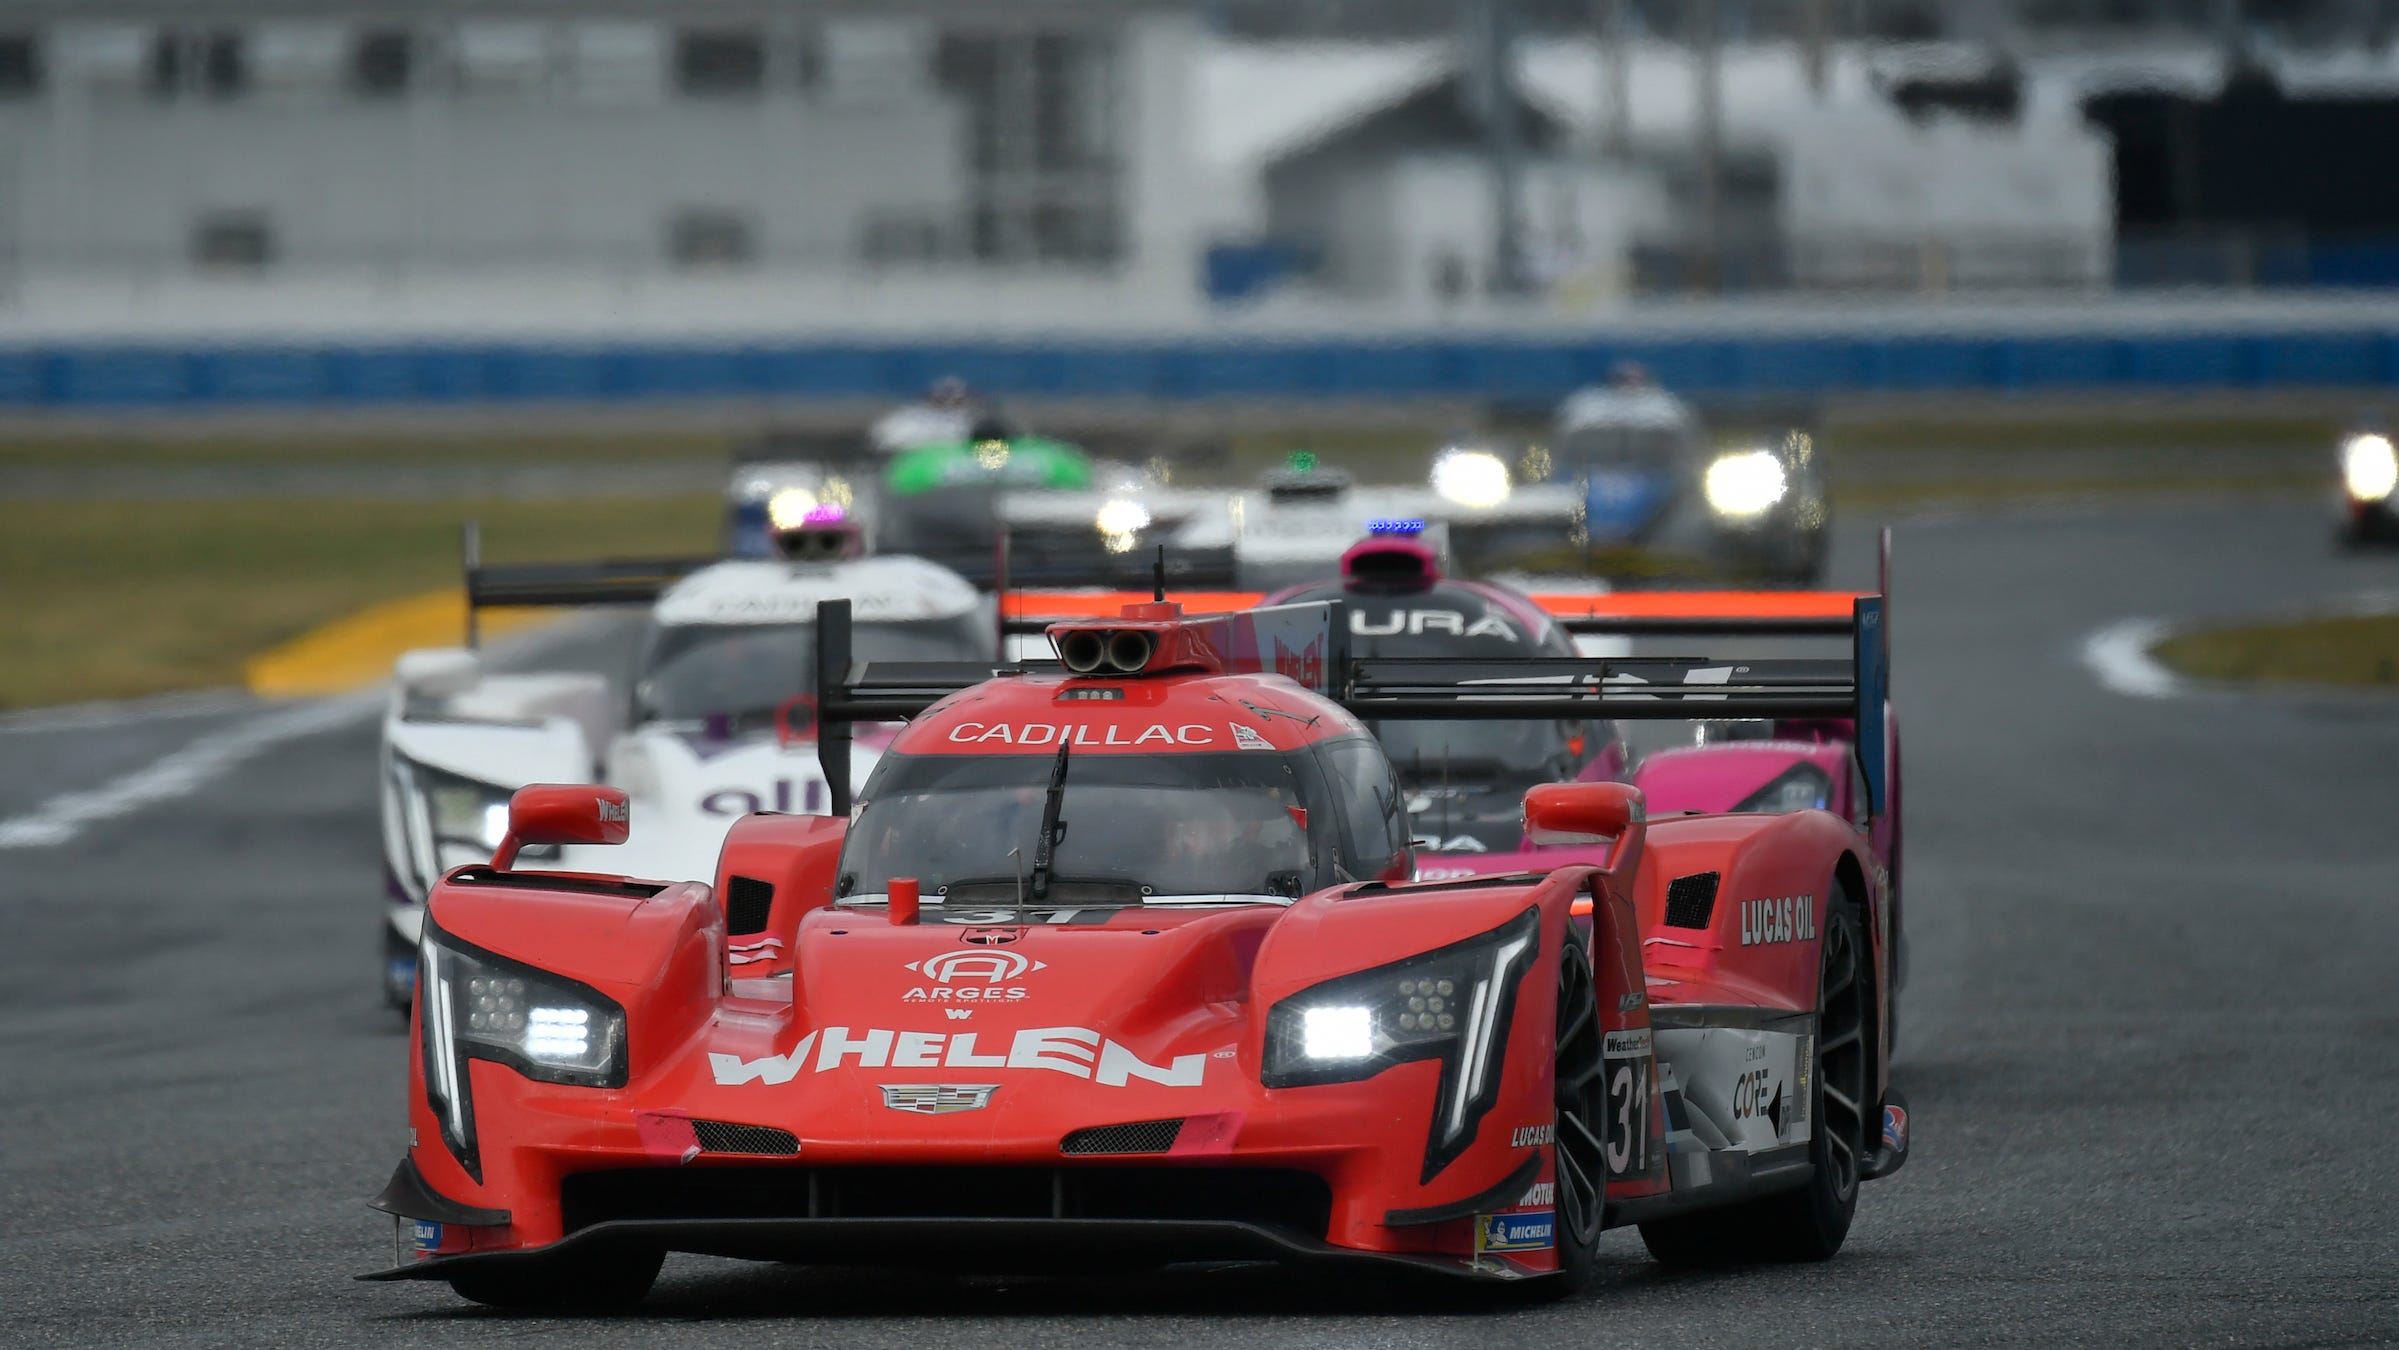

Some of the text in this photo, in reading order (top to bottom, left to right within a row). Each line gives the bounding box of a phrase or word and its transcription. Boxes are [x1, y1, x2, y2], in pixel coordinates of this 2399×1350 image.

[948, 722, 1213, 745] CADILLAC
[702, 779, 822, 815] all
[1741, 894, 1815, 946] LUCAS OIL
[902, 987, 1027, 999] ARGES
[707, 1026, 1208, 1087] WHELEN
[1733, 1068, 1768, 1120] CORE
[1511, 1124, 1545, 1147] LUCAS
[1607, 1063, 1647, 1174] 31
[1510, 1224, 1553, 1240] MICHELIN
